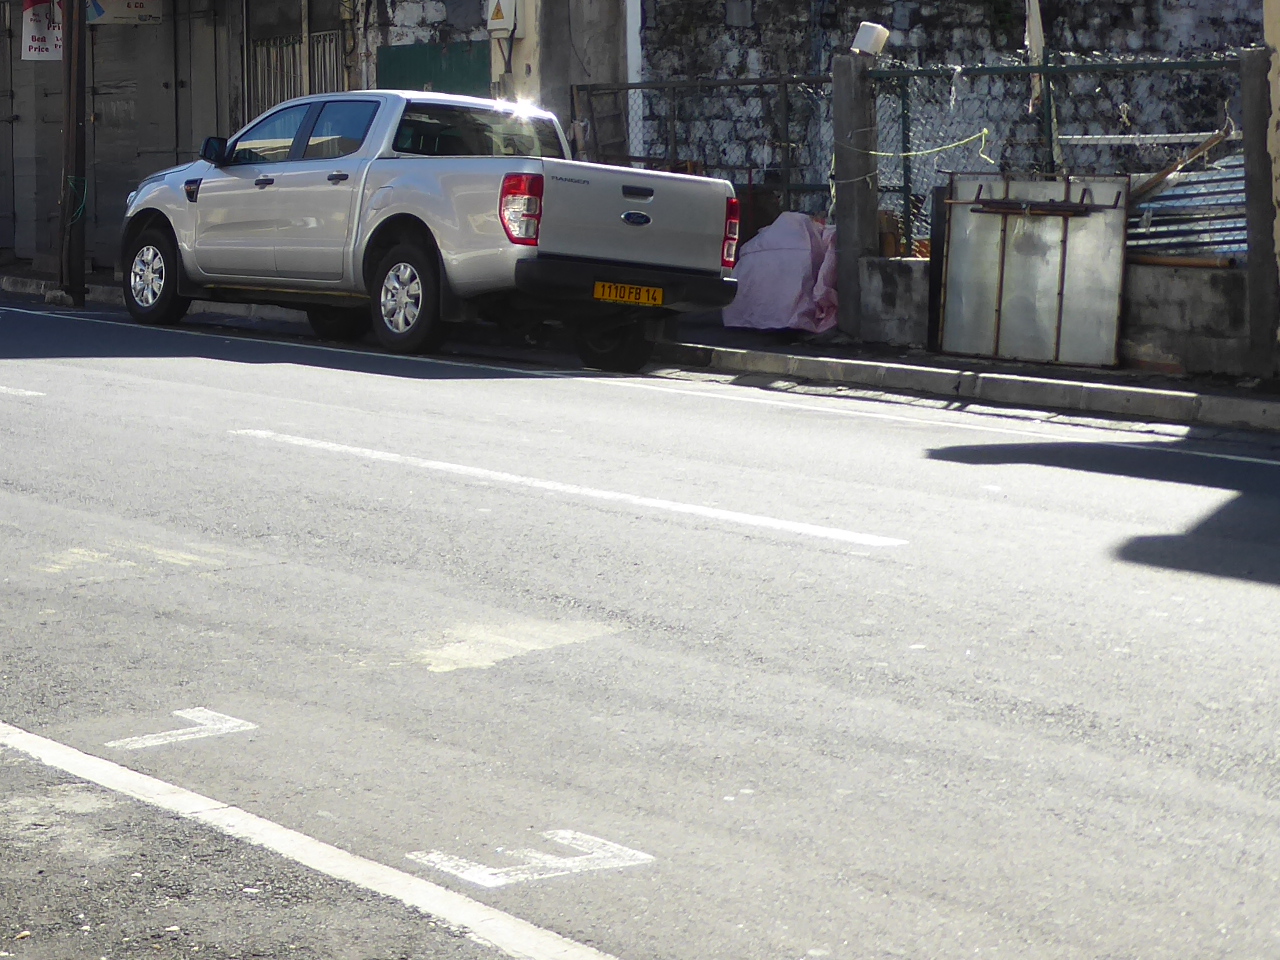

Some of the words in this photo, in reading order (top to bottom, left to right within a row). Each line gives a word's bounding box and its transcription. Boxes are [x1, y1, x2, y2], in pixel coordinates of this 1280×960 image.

[28, 45, 50, 53] Price
[600, 283, 625, 299] 1110
[627, 285, 641, 301] FB
[645, 288, 658, 303] 14
